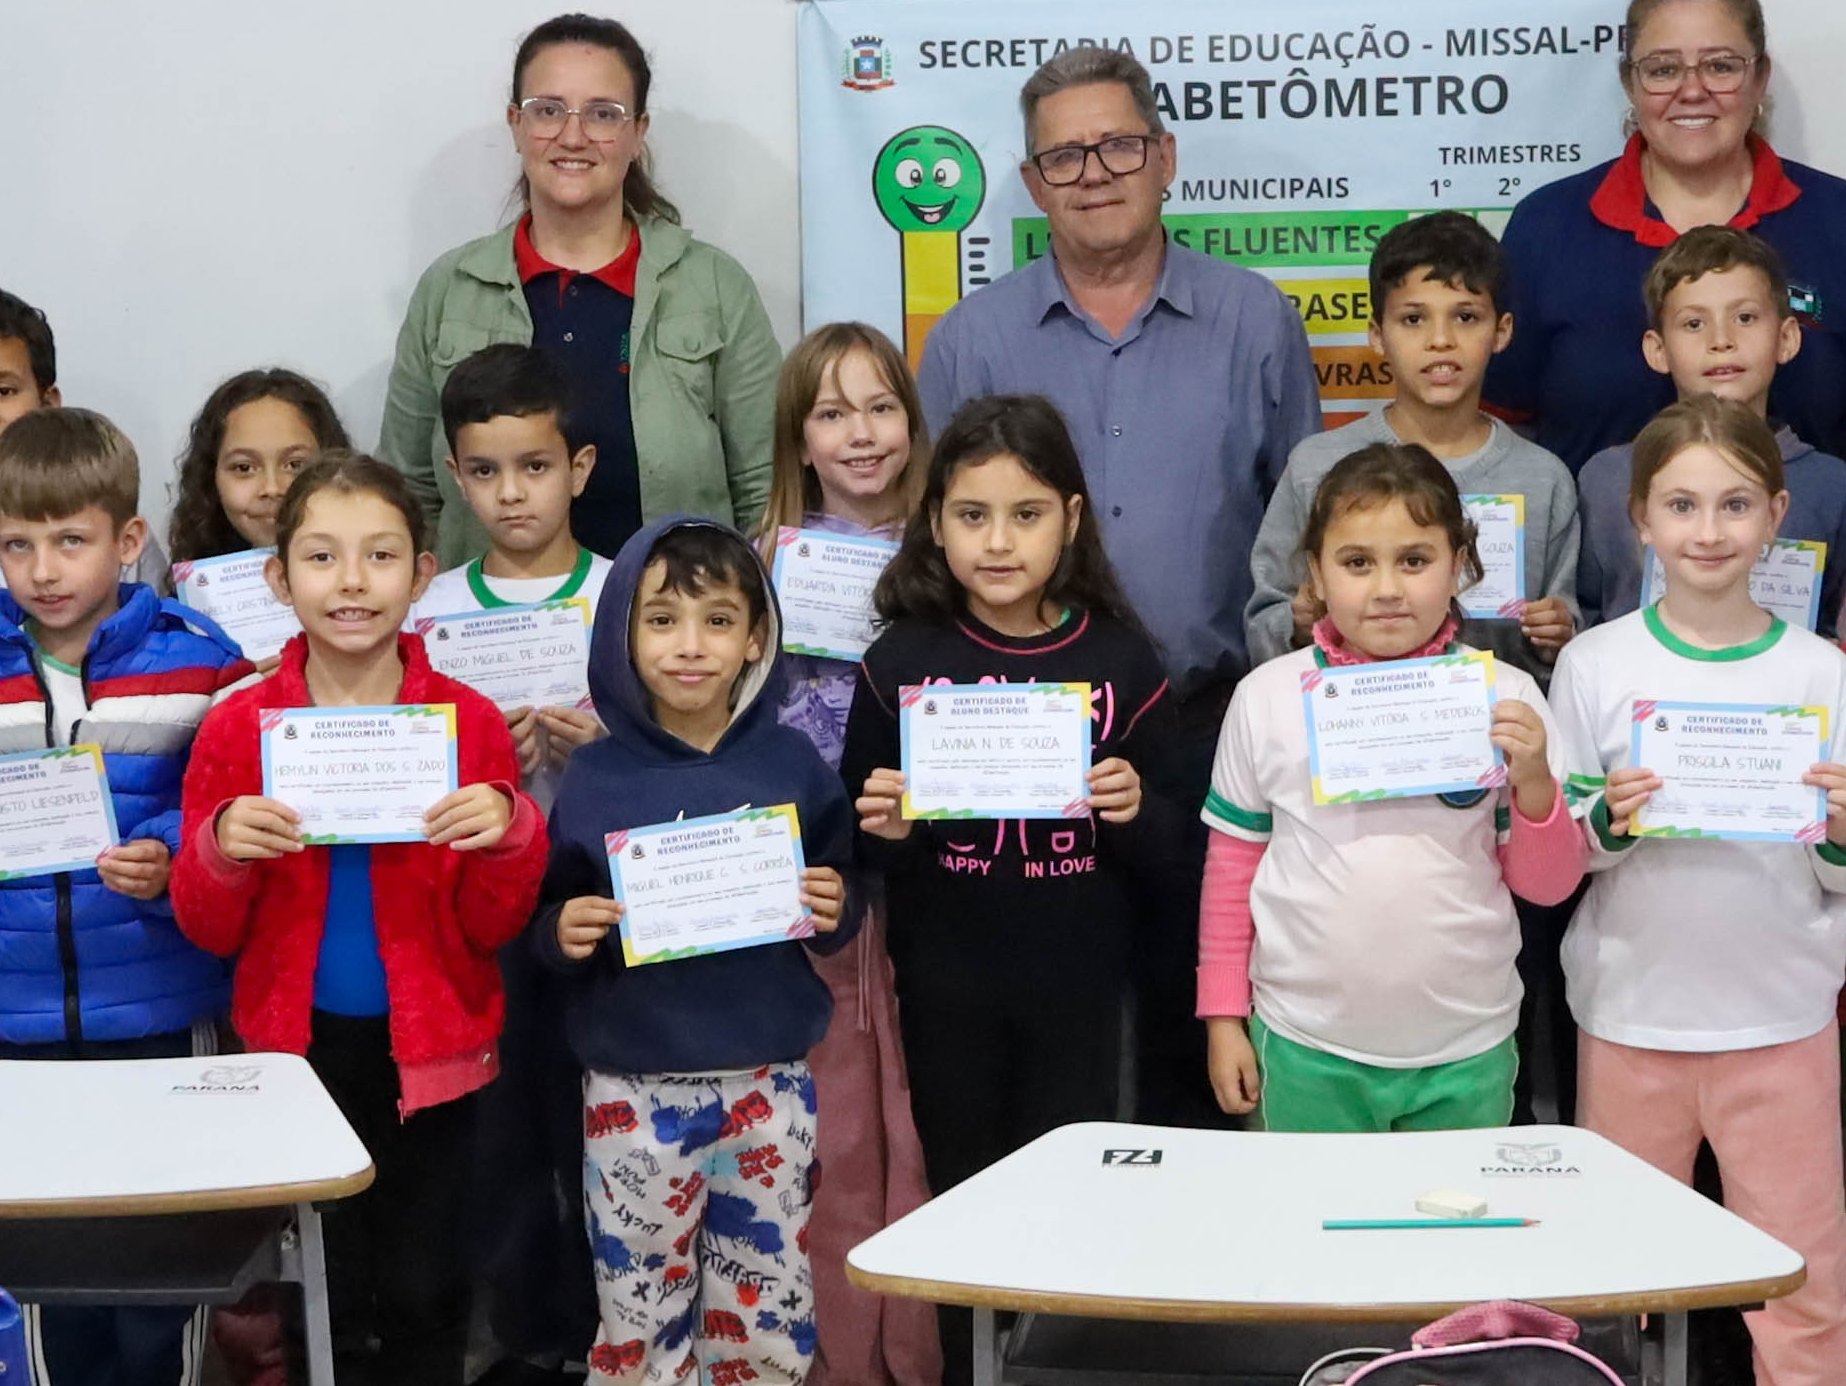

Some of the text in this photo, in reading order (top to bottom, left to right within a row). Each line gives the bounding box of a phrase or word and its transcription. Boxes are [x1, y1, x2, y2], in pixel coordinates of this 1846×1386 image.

[1150, 36, 1195, 65] DE
[1208, 24, 1410, 68] EDUCAÇÃO
[1439, 143, 1582, 167] TRIMESTRES
[1181, 177, 1350, 201] MUNICIPAIS
[1204, 224, 1381, 255] FLUENTES
[519, 648, 535, 660] DE
[540, 644, 577, 658] SOUZA
[999, 736, 1015, 750] DE
[1020, 736, 1060, 750] SOUZA
[1025, 861, 1044, 878] IN
[1050, 856, 1096, 877] LOVE
